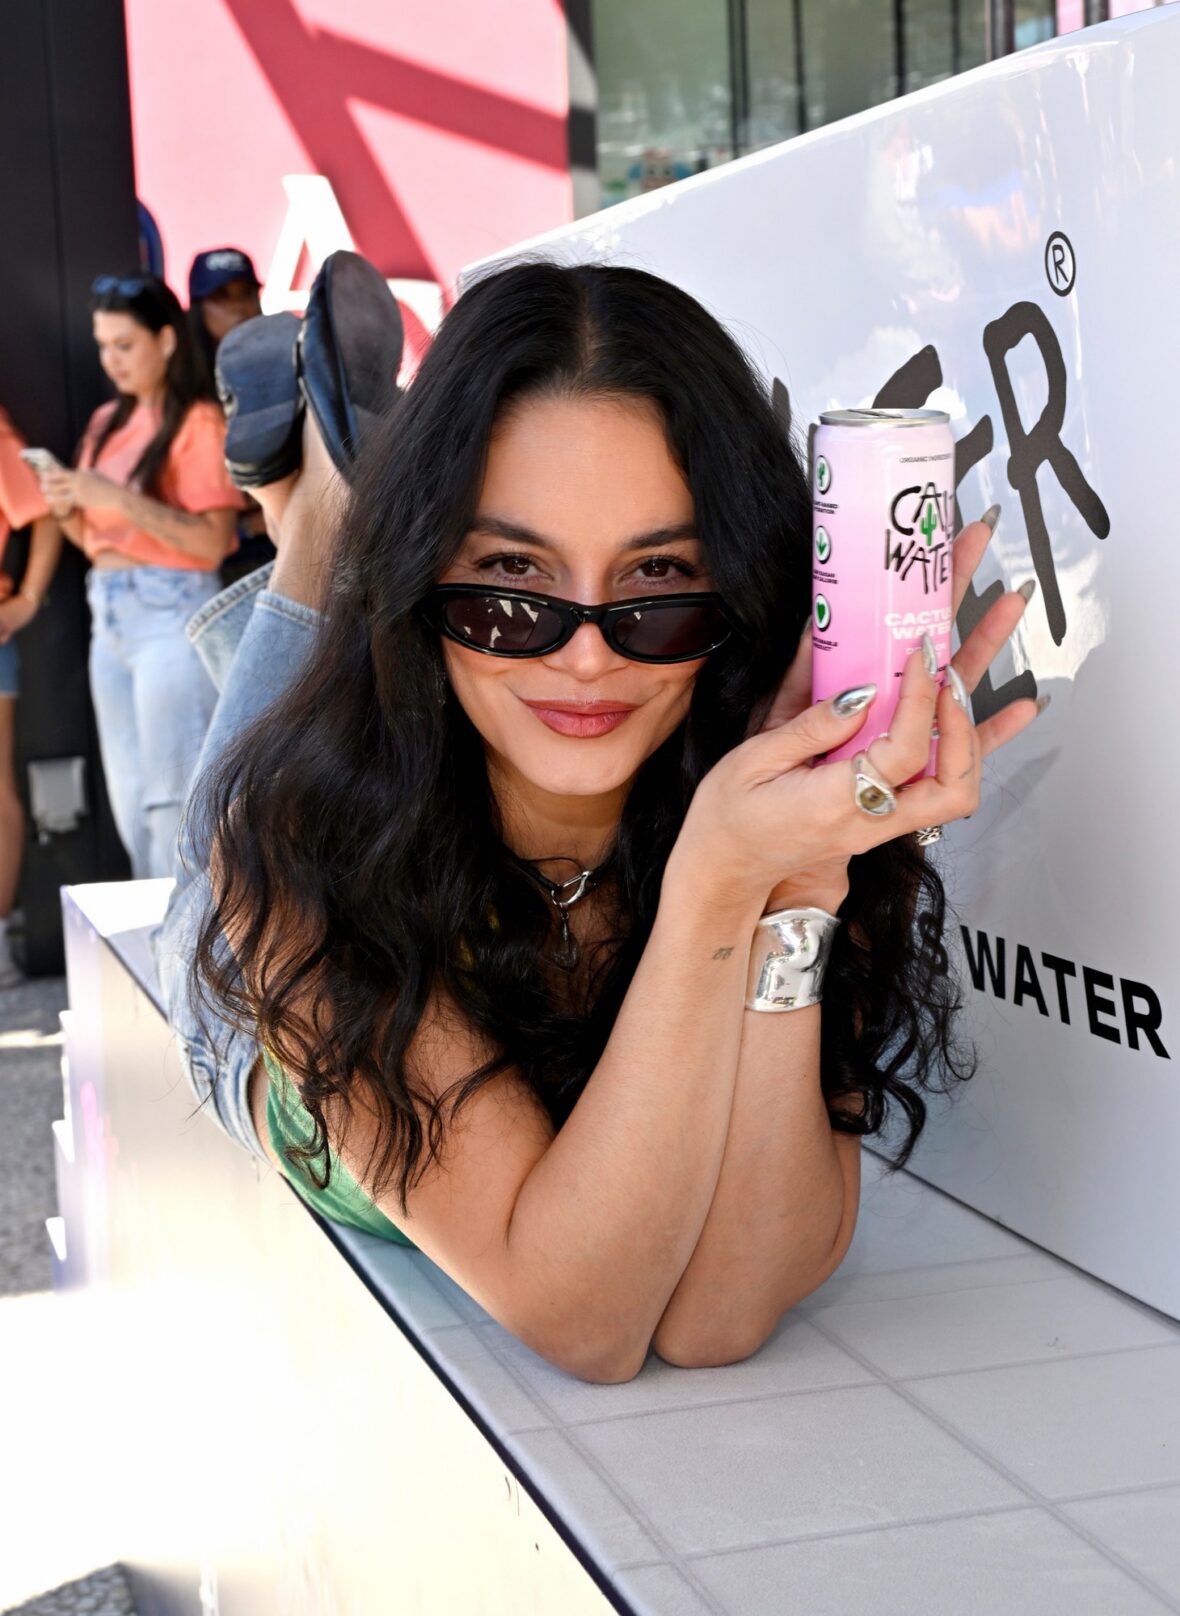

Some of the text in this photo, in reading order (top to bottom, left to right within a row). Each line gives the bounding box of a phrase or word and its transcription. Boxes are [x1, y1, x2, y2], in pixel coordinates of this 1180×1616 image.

[885, 529, 950, 595] WATE
[884, 607, 951, 627] CACTU
[959, 924, 1171, 1060] WATER
